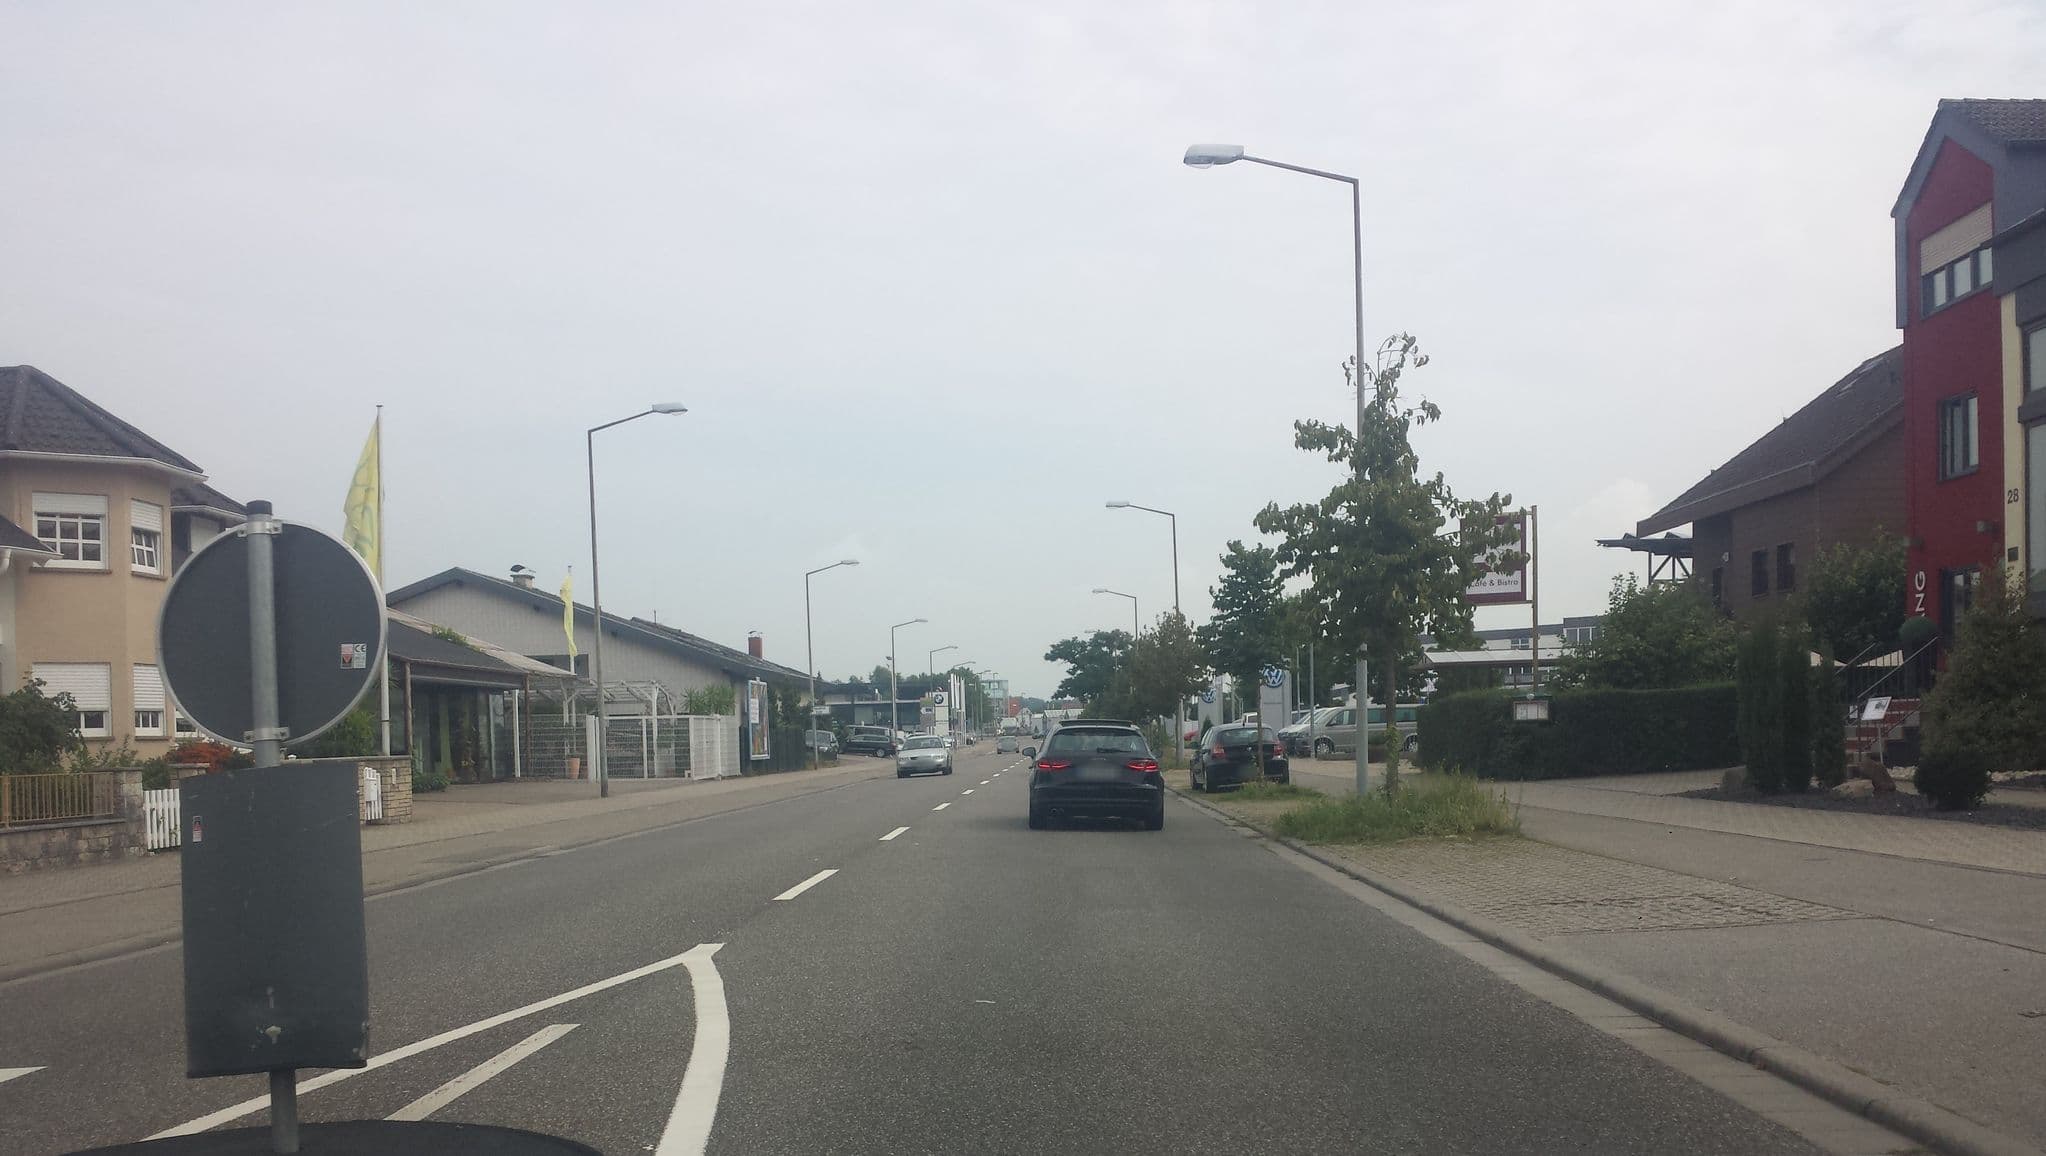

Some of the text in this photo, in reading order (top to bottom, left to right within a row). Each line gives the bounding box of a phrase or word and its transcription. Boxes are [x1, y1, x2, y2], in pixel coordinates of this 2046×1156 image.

[2007, 488, 2019, 504] 28
[1915, 571, 1925, 616] NG
[353, 644, 366, 652] CE
